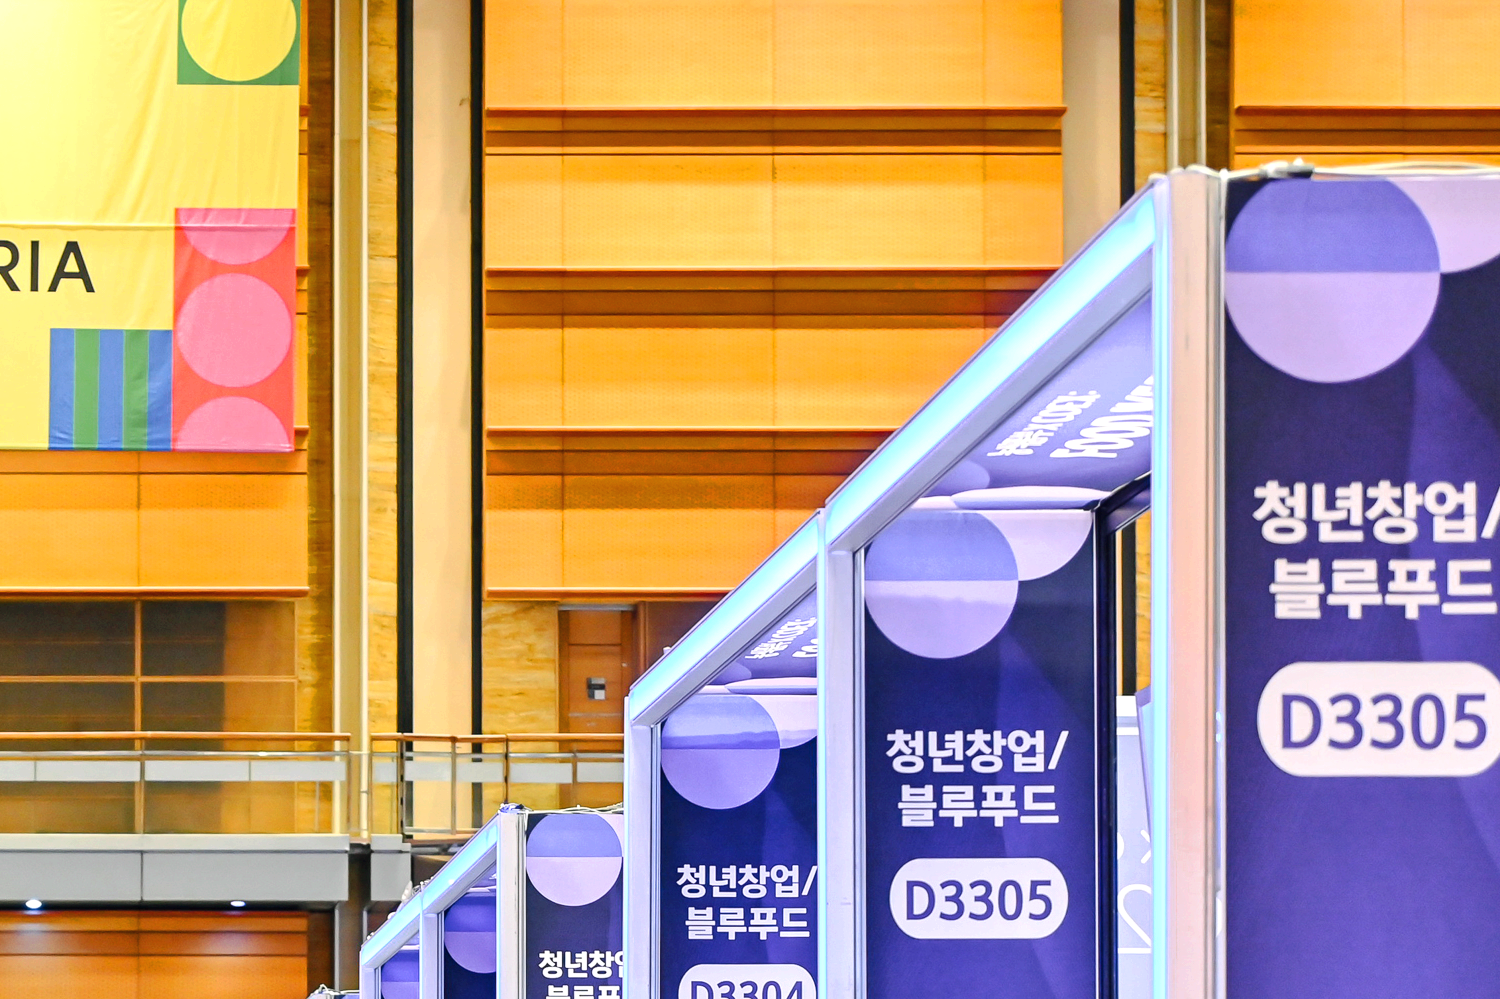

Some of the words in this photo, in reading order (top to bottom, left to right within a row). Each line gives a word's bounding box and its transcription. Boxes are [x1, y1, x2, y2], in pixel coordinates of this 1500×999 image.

[1252, 480, 1500, 545] 청년창업/
[1268, 558, 1498, 620] 블루푸드
[1281, 692, 1488, 750] D3305
[885, 729, 1070, 774] 청년창업/
[897, 784, 1060, 828] 블루푸드
[676, 864, 817, 899] 청년창업/
[906, 879, 1054, 922] D3305
[684, 907, 810, 941] 블루푸드
